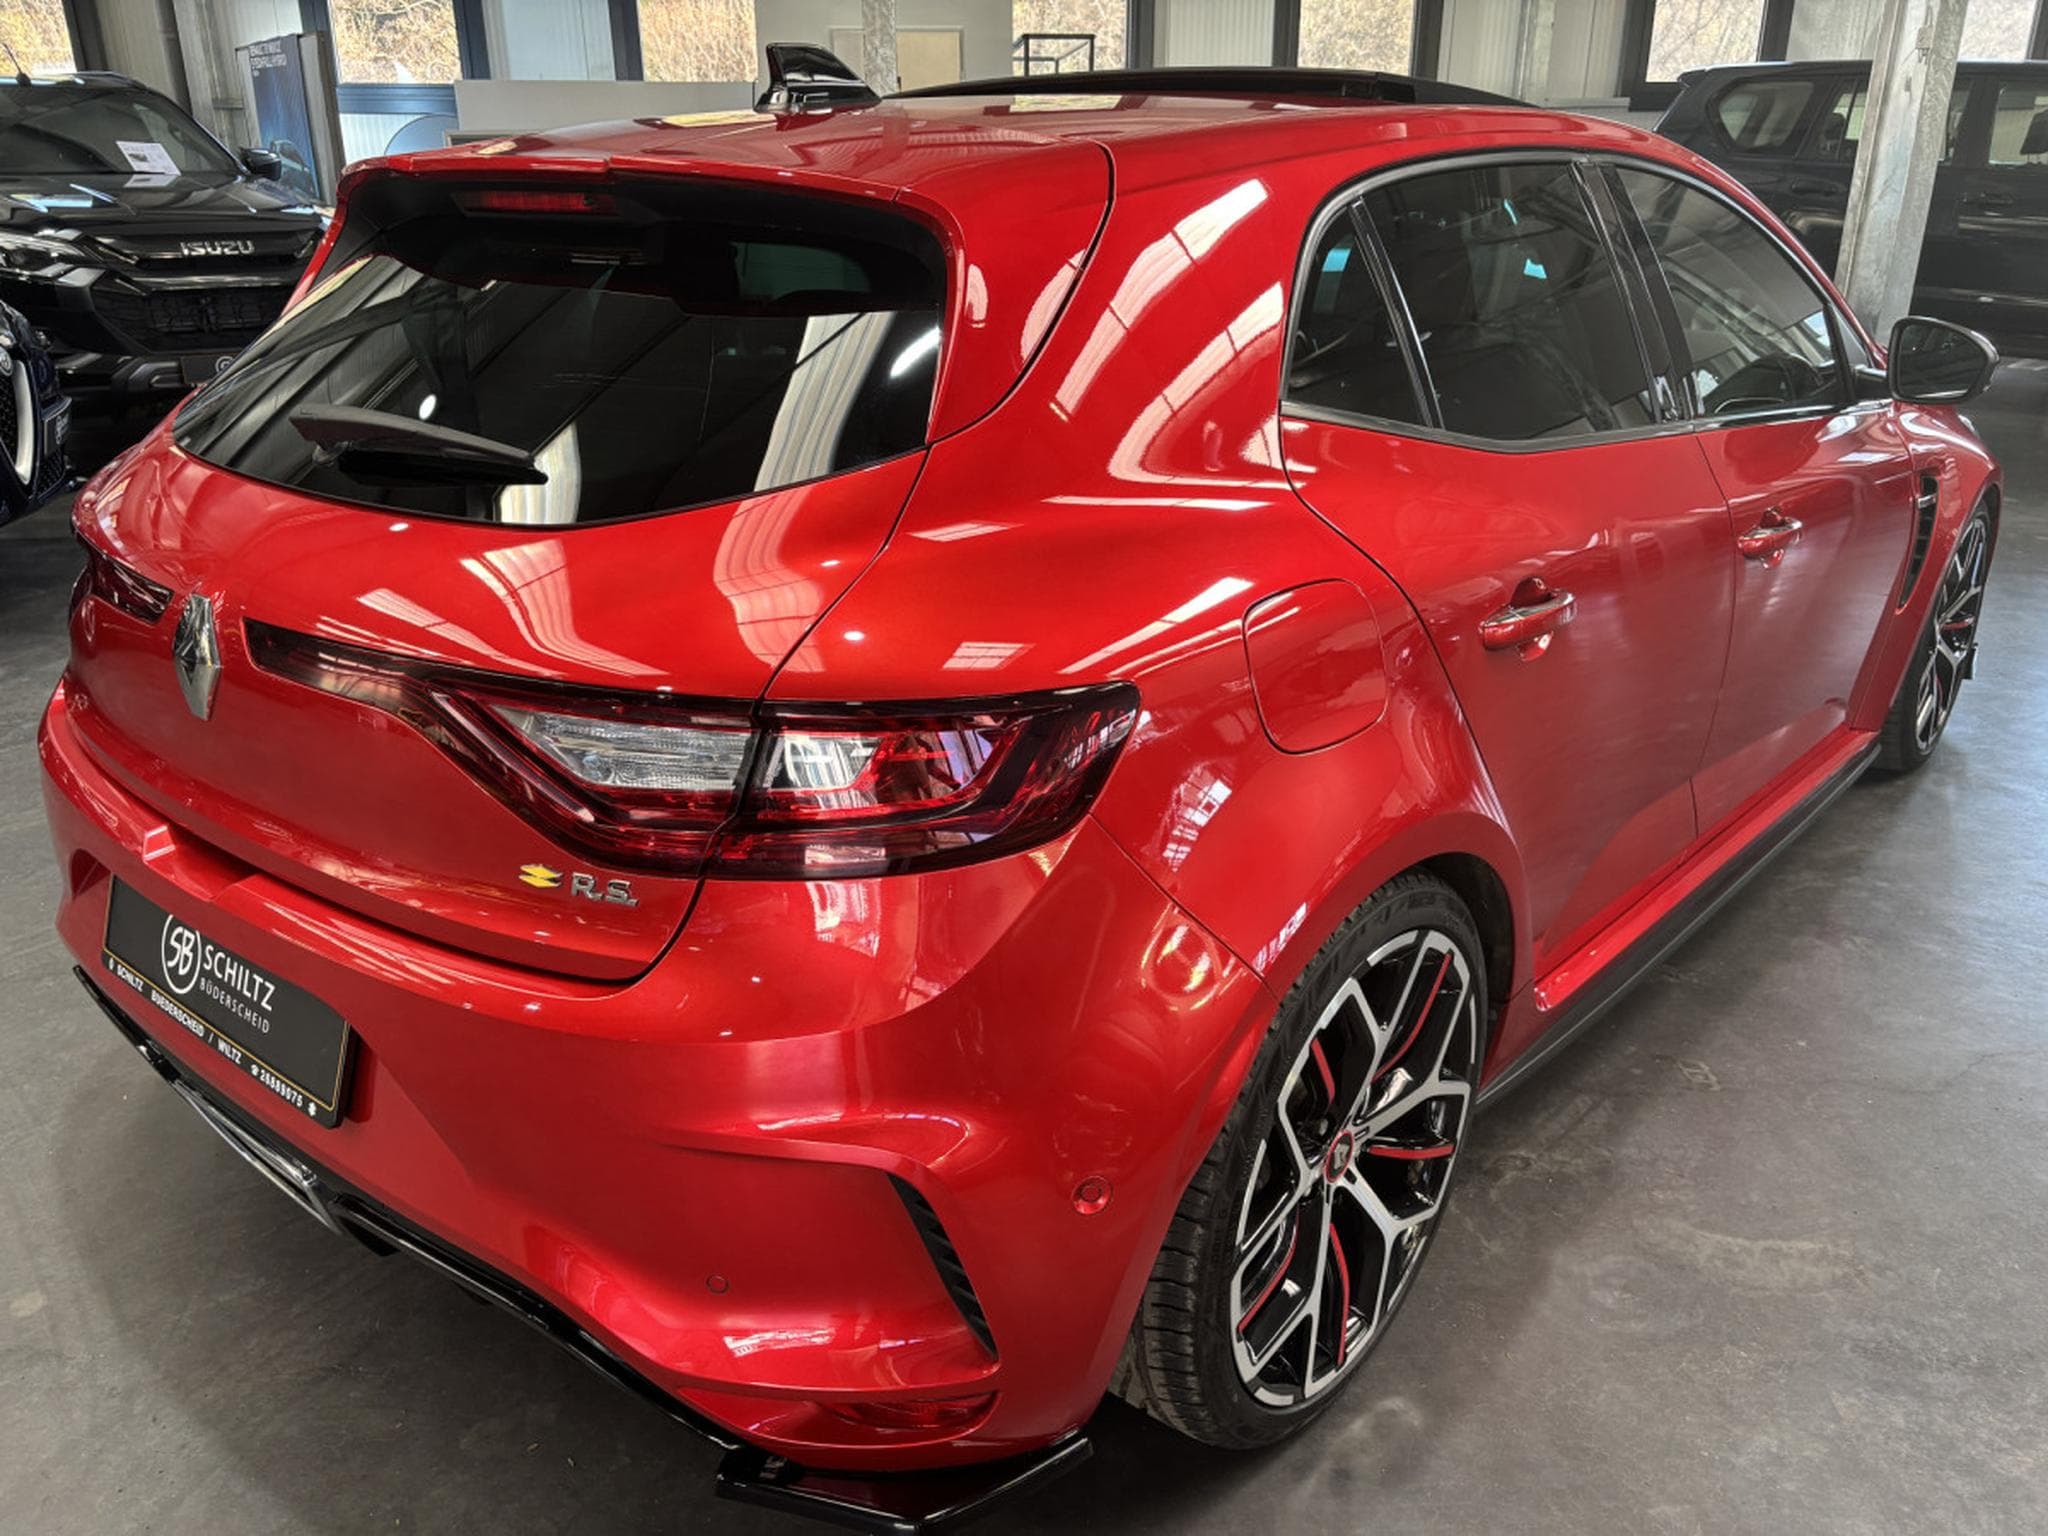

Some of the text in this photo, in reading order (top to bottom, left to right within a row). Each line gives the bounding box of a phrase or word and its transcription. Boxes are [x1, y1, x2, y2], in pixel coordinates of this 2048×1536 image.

[179, 239, 255, 256] ISUZU
[199, 977, 271, 1034] BÜDERSCHEID
[203, 944, 275, 1012] SCHILTZ
[116, 963, 145, 993] SCHILTZ
[217, 1037, 243, 1065] WILTZ
